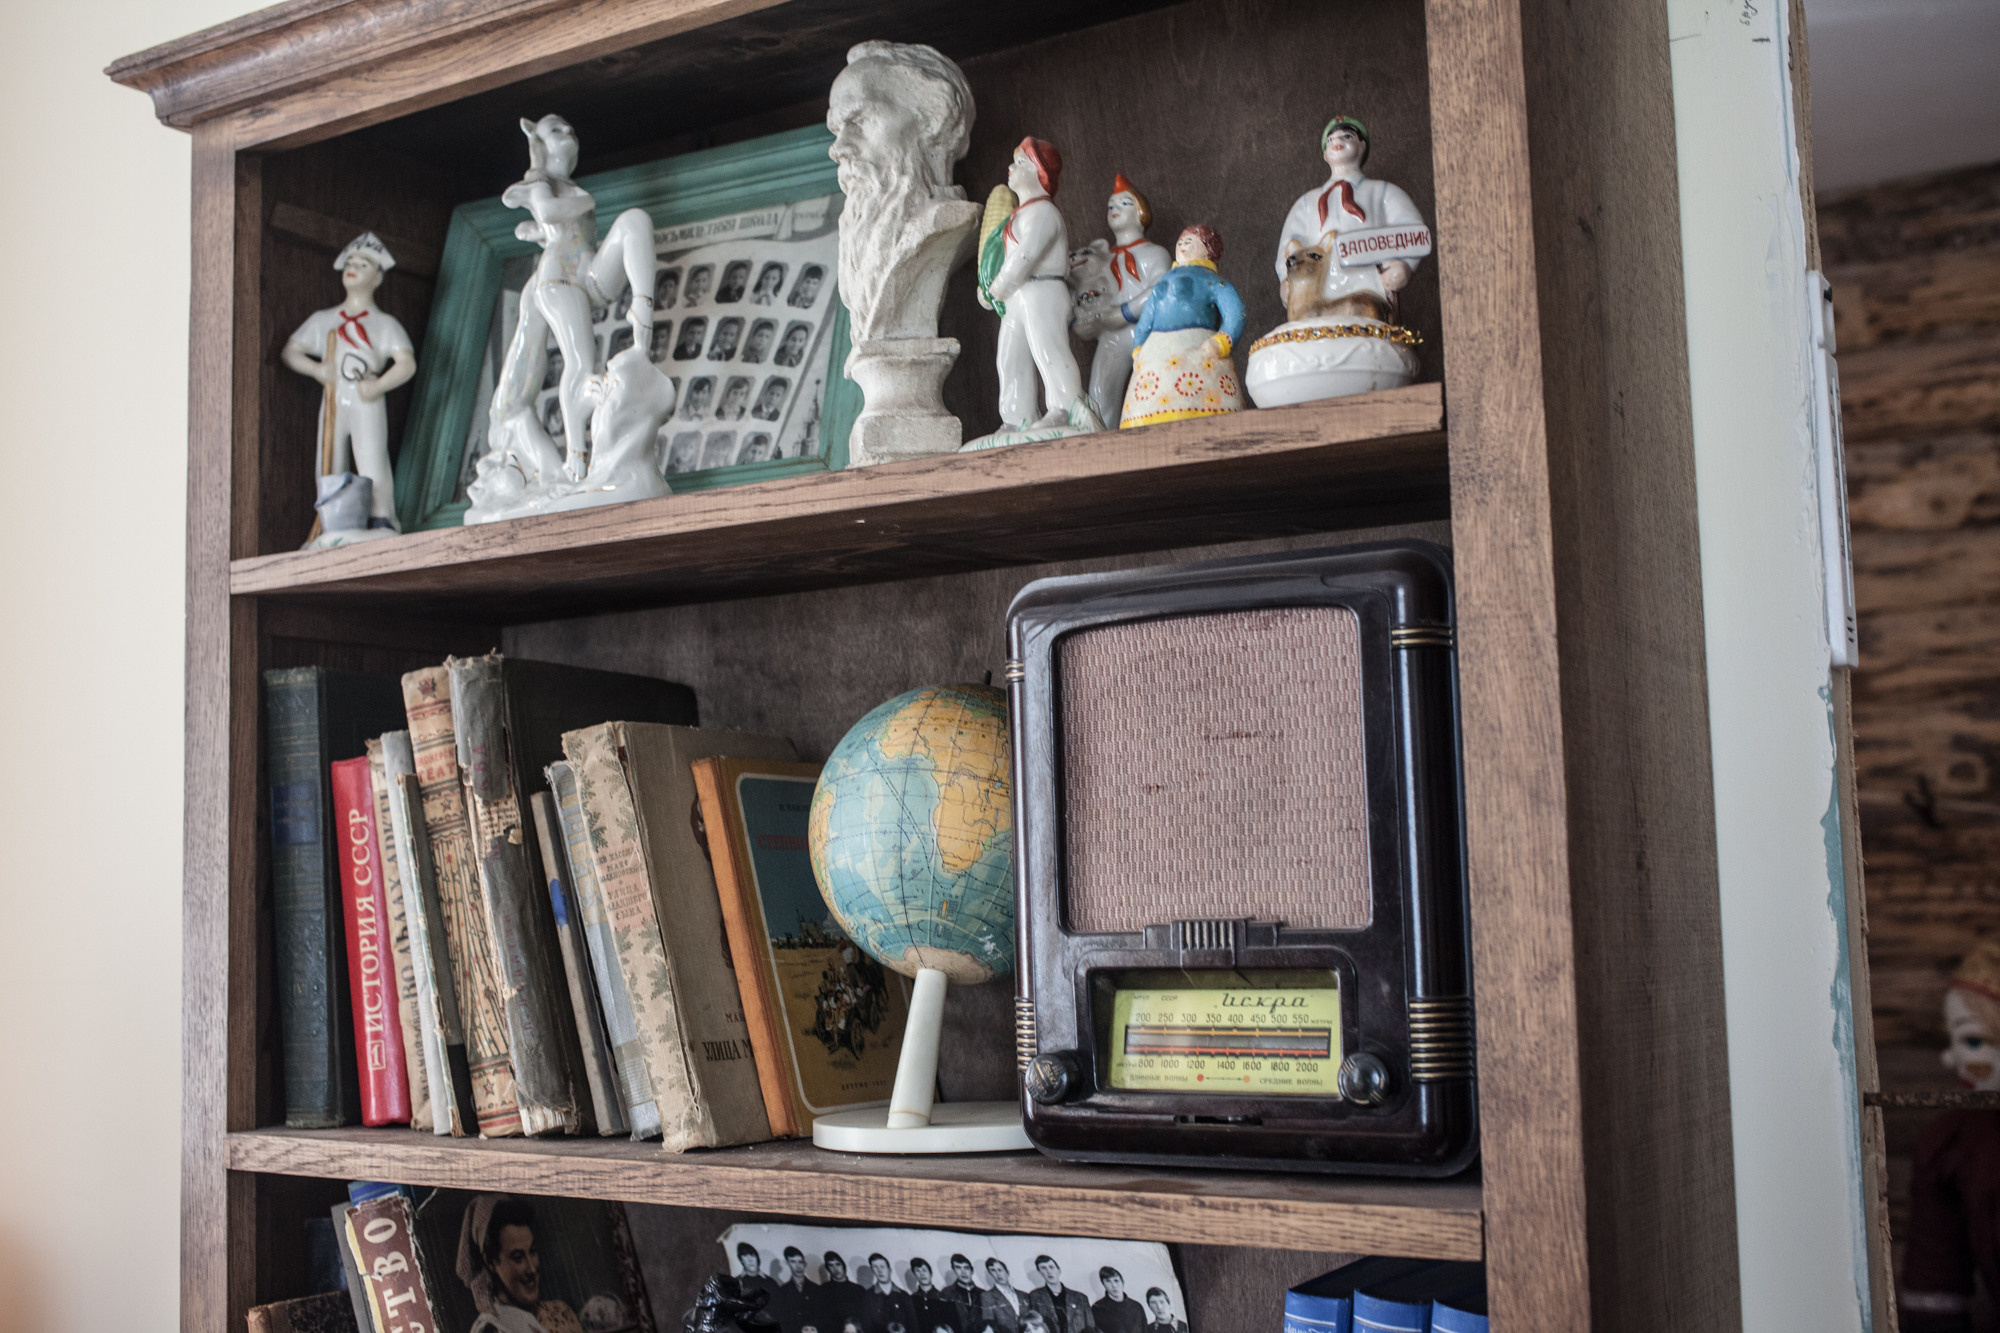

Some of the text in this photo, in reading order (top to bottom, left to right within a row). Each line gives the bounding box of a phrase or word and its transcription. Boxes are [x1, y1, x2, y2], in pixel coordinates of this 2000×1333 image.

[1338, 230, 1430, 258] ЗАПОВЕДНИК
[349, 808, 373, 887] СССР
[356, 894, 385, 1033] ИСТОРИЯ
[1136, 1013, 1151, 1023] 200
[1158, 1013, 1174, 1023] 250
[1181, 1013, 1197, 1023] 300
[1205, 1013, 1222, 1024] 350
[1228, 1013, 1244, 1024] 400
[1250, 1014, 1267, 1024] 450
[1271, 1014, 1288, 1024] 500
[1292, 1014, 1310, 1024] 550
[701, 1039, 741, 1062] УЛИЦА
[1138, 1059, 1154, 1069] 800
[1160, 1059, 1180, 1069] 1000
[1186, 1060, 1206, 1070] 1200
[1217, 1060, 1236, 1071] 1400
[1242, 1061, 1262, 1071] 1600
[1270, 1061, 1290, 1072] 1800
[1295, 1062, 1319, 1072] 2000
